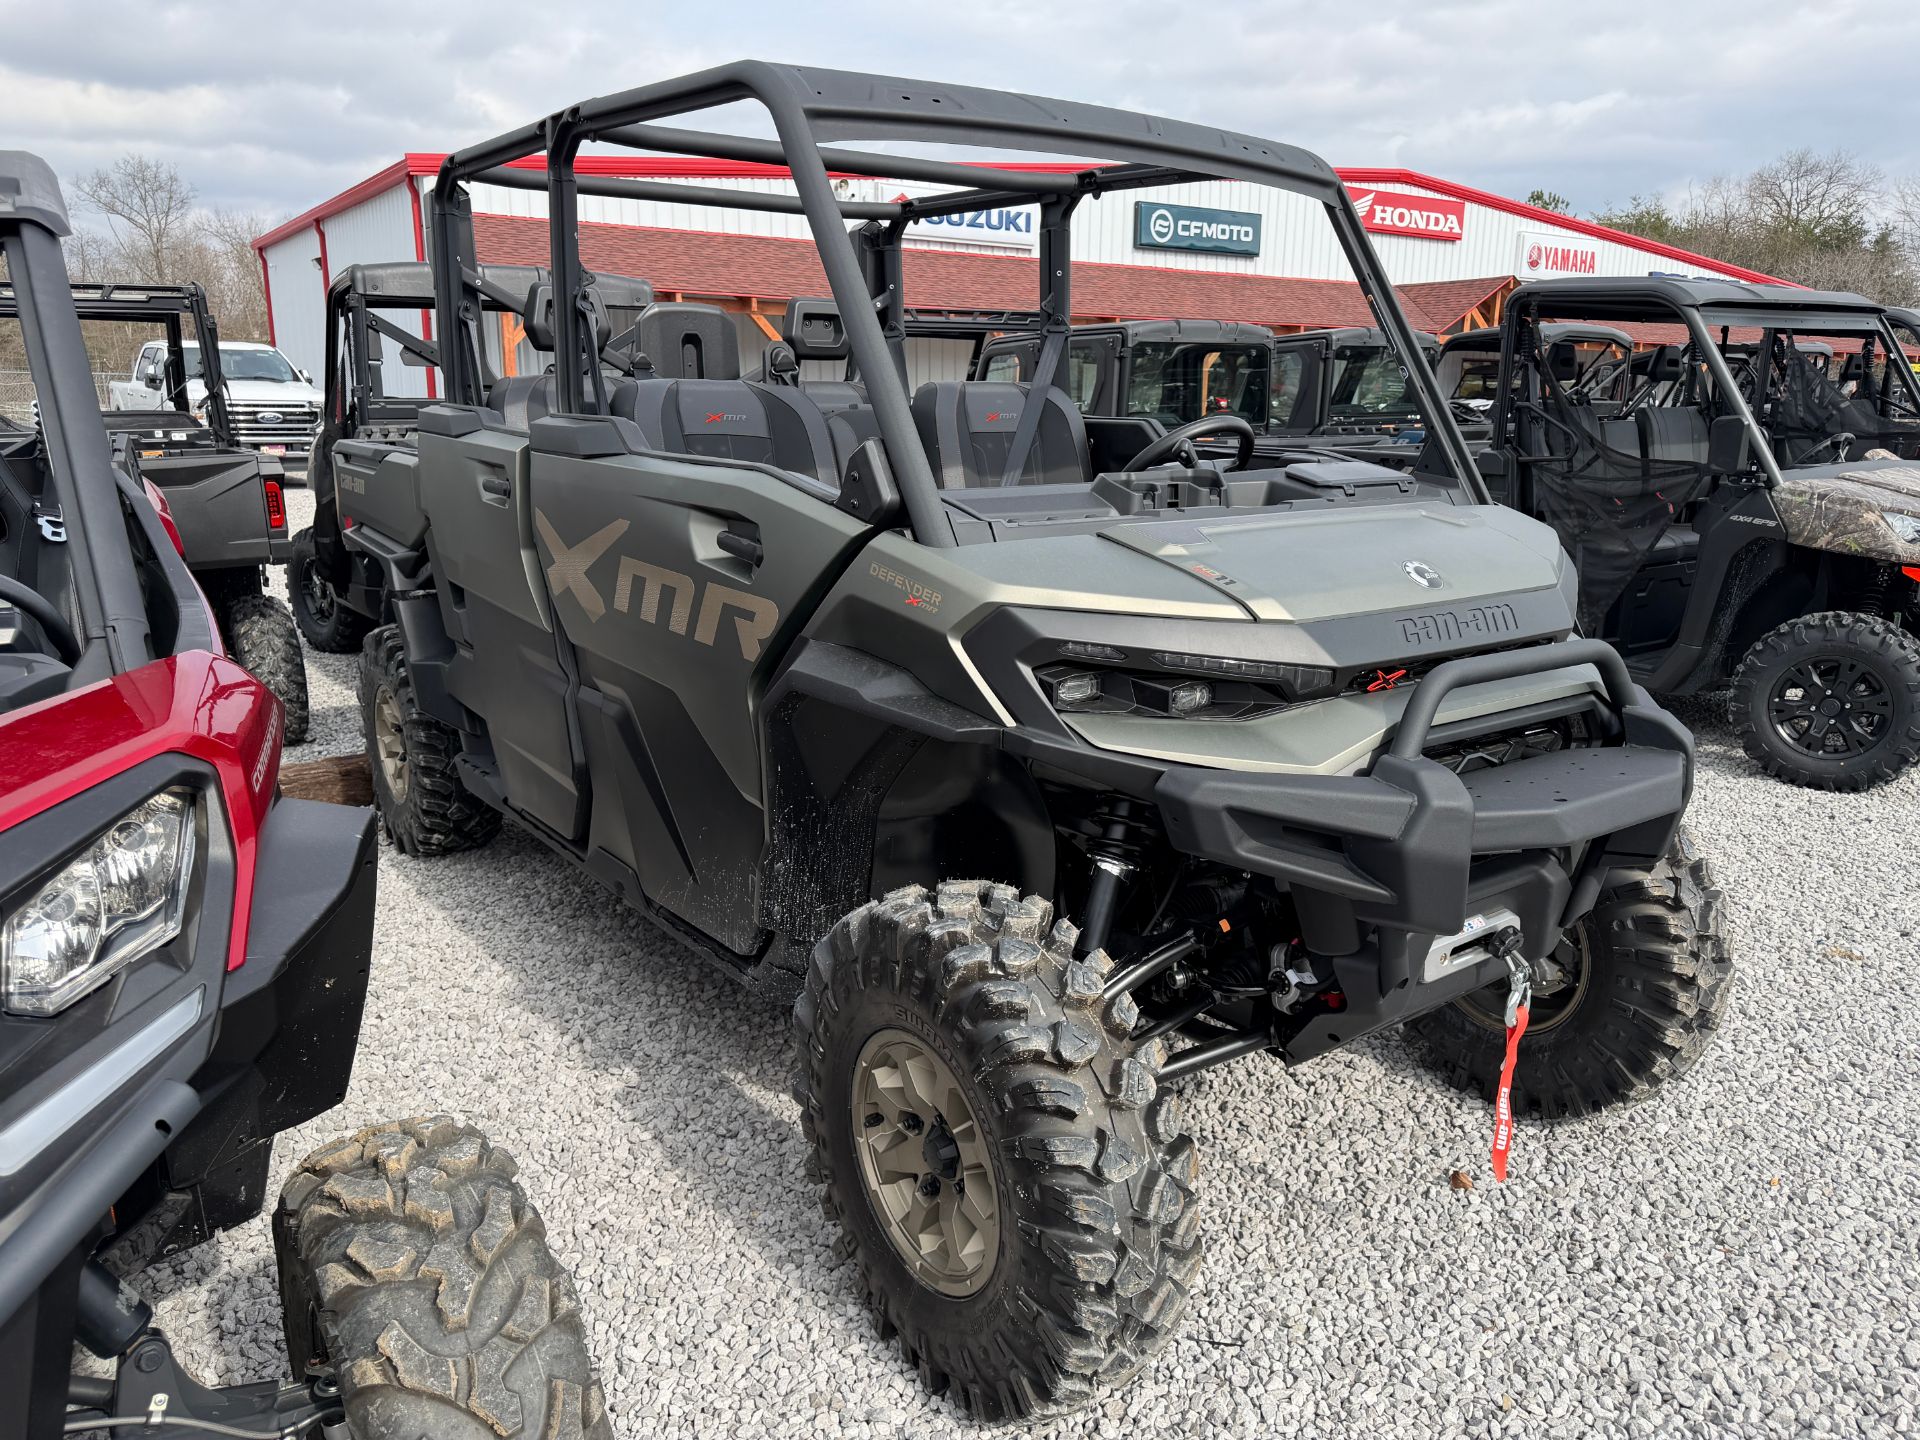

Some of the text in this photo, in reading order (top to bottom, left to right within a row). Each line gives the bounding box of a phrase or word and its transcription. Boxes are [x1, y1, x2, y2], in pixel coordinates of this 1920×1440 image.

[1177, 220, 1253, 242] CFMOTO
[1372, 205, 1462, 233] HONDA
[1543, 246, 1596, 274] YAMAHA
[1752, 518, 1778, 527] EPS
[870, 562, 942, 606] DEFENDER
